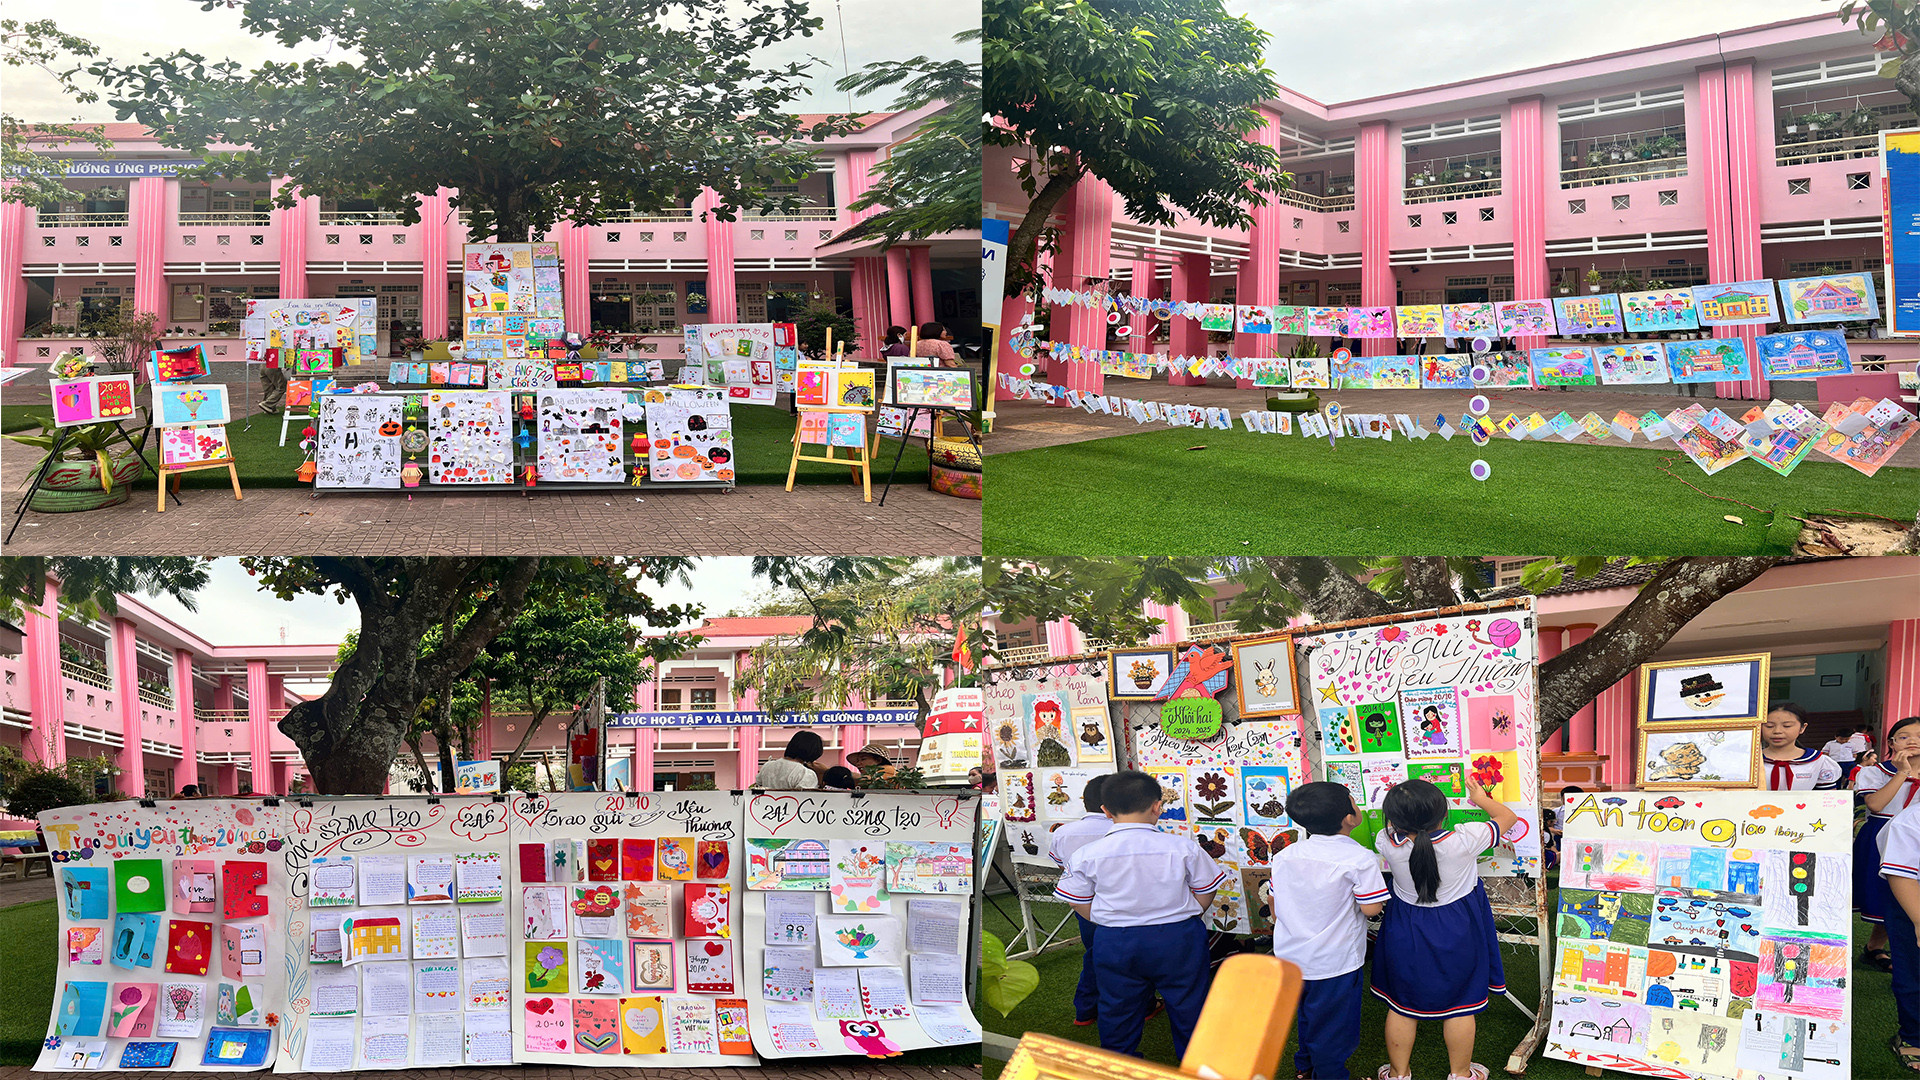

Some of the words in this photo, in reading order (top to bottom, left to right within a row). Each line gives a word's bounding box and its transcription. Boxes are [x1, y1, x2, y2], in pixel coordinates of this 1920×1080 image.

[115, 161, 144, 174] ỨNG
[507, 362, 533, 377] SÁNG
[531, 377, 538, 387] 3
[665, 400, 719, 408] HALLOWEEN
[1318, 638, 1405, 676] Trao
[623, 714, 647, 726] CỰC
[650, 716, 675, 726] HỌC
[679, 713, 703, 726] TẬP
[706, 713, 722, 724] VÀ
[726, 713, 753, 724] LÀM
[822, 713, 863, 722] GƯƠNG
[866, 713, 892, 724] ĐẠO
[1196, 705, 1213, 724] hai
[520, 801, 544, 815] 2A6
[762, 802, 790, 822] 2A1
[798, 798, 837, 824] Góc
[463, 809, 495, 829] 2A6
[542, 809, 587, 828] Trao
[1565, 794, 1624, 827] An
[1629, 799, 1695, 832] toàn
[1700, 817, 1766, 848] giao
[45, 824, 100, 850] Trao
[134, 825, 176, 849] yêu
[215, 828, 249, 847] 20/10
[175, 843, 199, 856] 2A3
